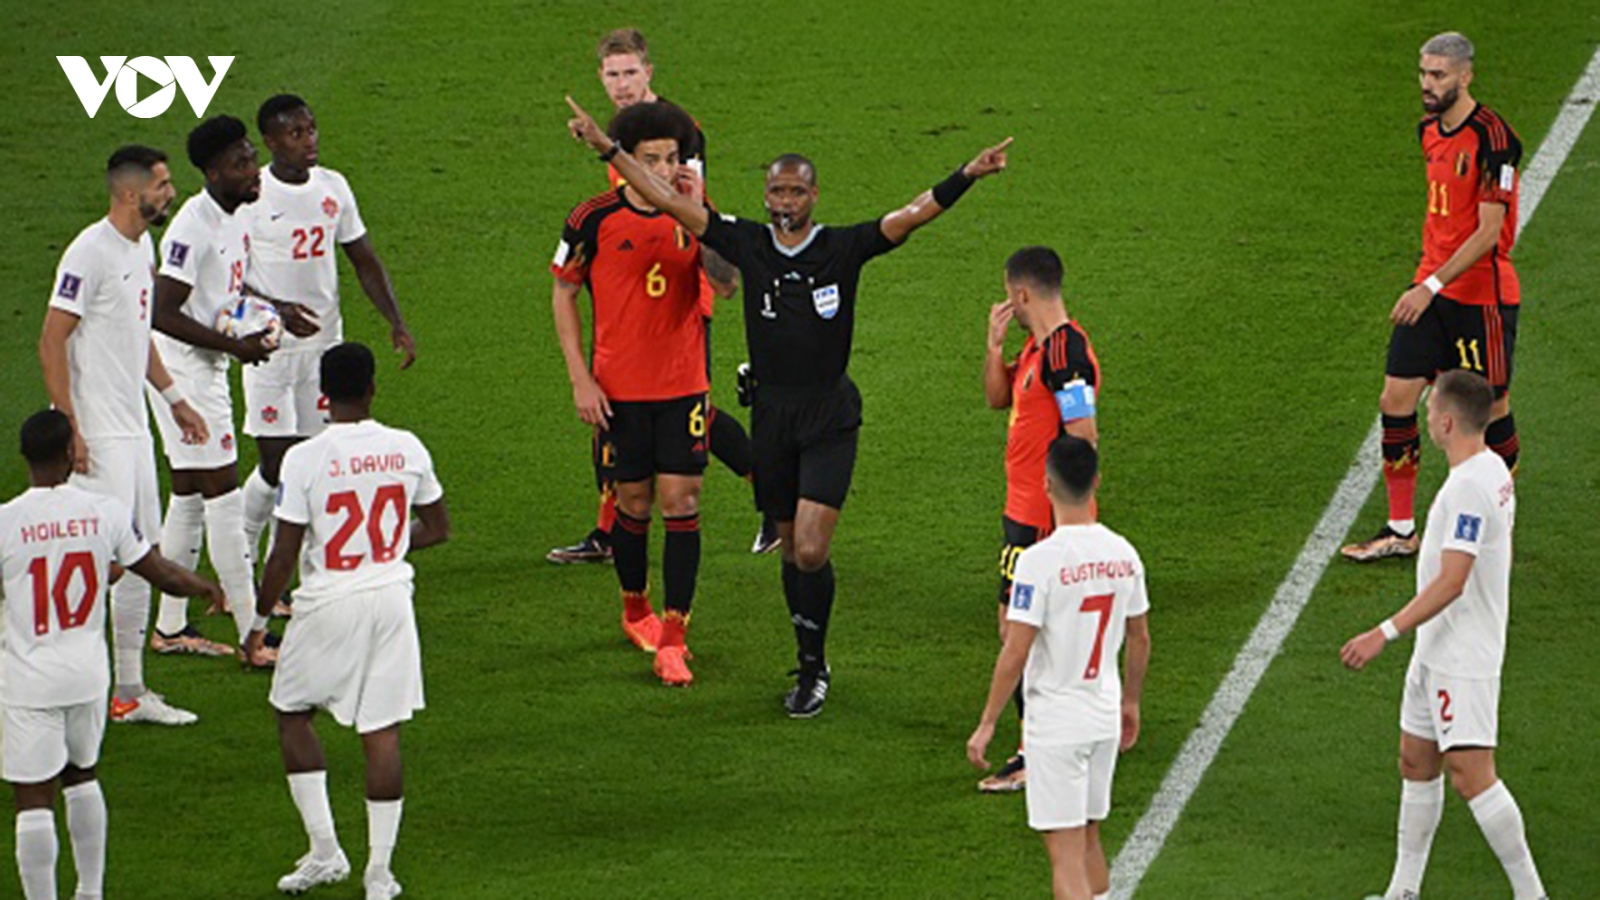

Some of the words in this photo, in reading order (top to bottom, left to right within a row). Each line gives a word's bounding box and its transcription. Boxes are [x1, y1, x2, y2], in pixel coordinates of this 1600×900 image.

[1429, 180, 1450, 216] 11
[292, 226, 325, 260] 22
[645, 262, 667, 297] 6
[1456, 338, 1483, 371] 11
[688, 402, 706, 437] 6
[328, 460, 346, 478] J.
[350, 453, 406, 475] DAVID
[21, 518, 99, 544] HOILETT
[324, 482, 407, 571] 20
[28, 550, 99, 636] 10
[1079, 592, 1116, 680] 7
[1437, 690, 1454, 722] 2
